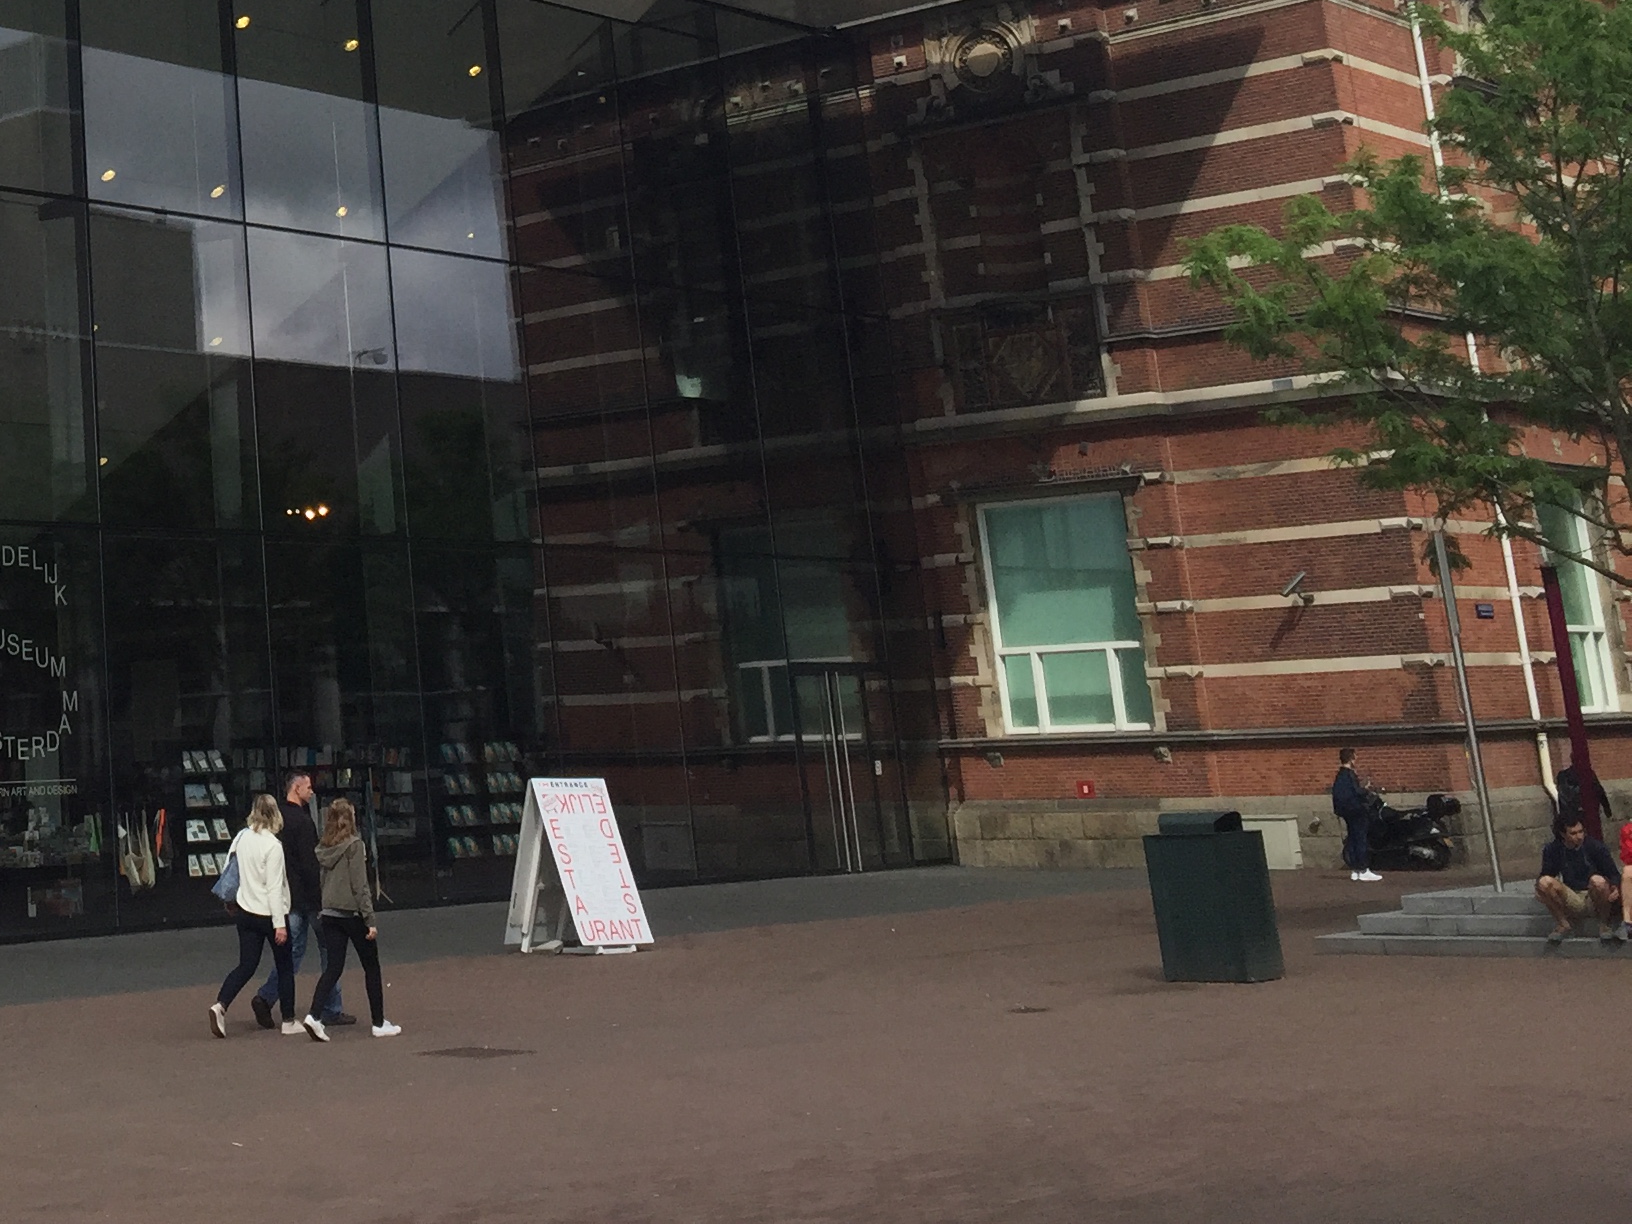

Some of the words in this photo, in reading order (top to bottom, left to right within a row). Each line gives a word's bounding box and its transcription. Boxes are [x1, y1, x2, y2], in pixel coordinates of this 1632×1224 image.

[11, 787, 27, 797] ART
[28, 785, 46, 796] AND
[47, 784, 78, 795] DESIGN
